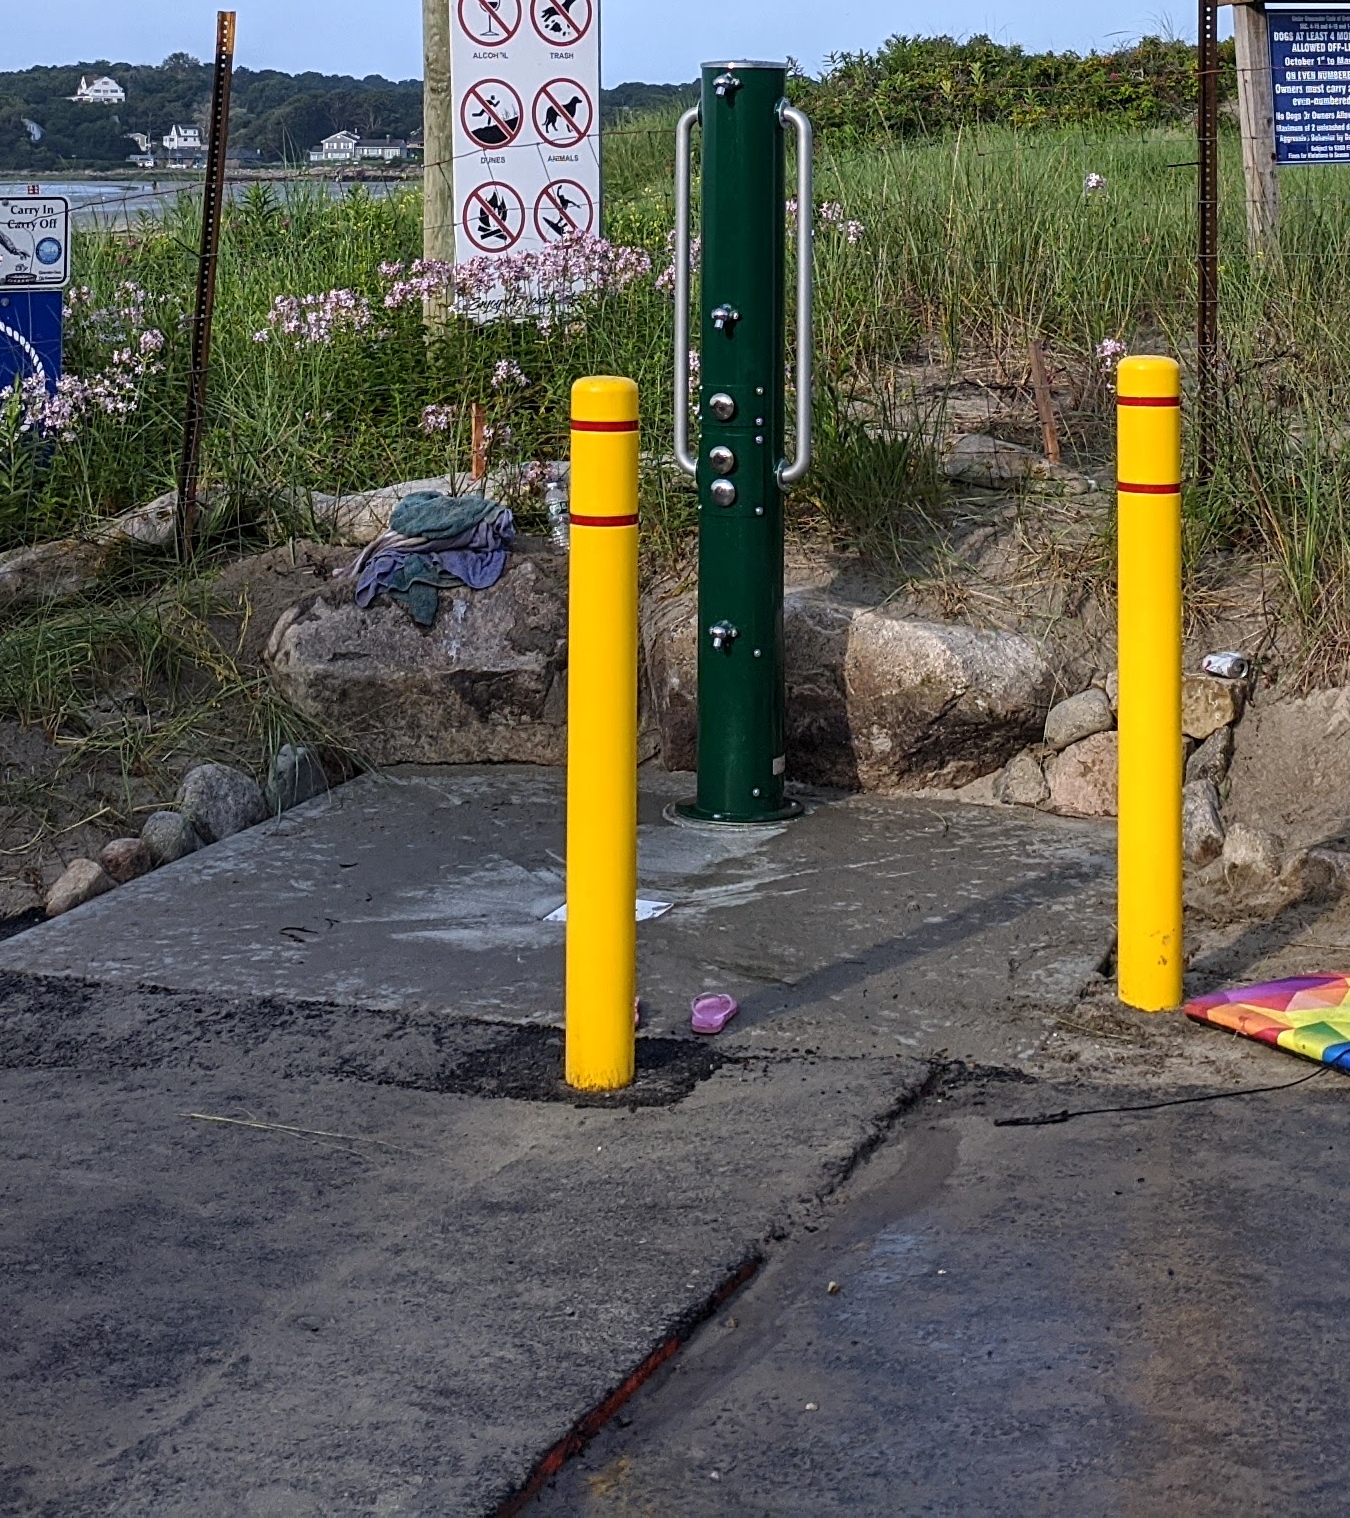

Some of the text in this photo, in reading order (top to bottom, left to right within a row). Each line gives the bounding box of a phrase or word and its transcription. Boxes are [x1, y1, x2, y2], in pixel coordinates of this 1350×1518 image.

[1274, 31, 1293, 41] DOGS
[1295, 32, 1304, 41] AT
[1306, 32, 1328, 40] LEAST
[1330, 32, 1334, 40] 4
[1292, 43, 1325, 52] ALLOWED
[1285, 57, 1314, 66] October
[1286, 71, 1296, 80] ON
[1298, 71, 1316, 80] EVEN
[1275, 84, 1303, 94] Owners
[1306, 84, 1324, 93] must
[1326, 84, 1346, 94] carry
[1276, 112, 1284, 120] No
[1286, 112, 1301, 121] Dogs
[1312, 111, 1335, 119] Owners
[11, 205, 54, 216] Carry In
[8, 219, 57, 231] Carry Off
